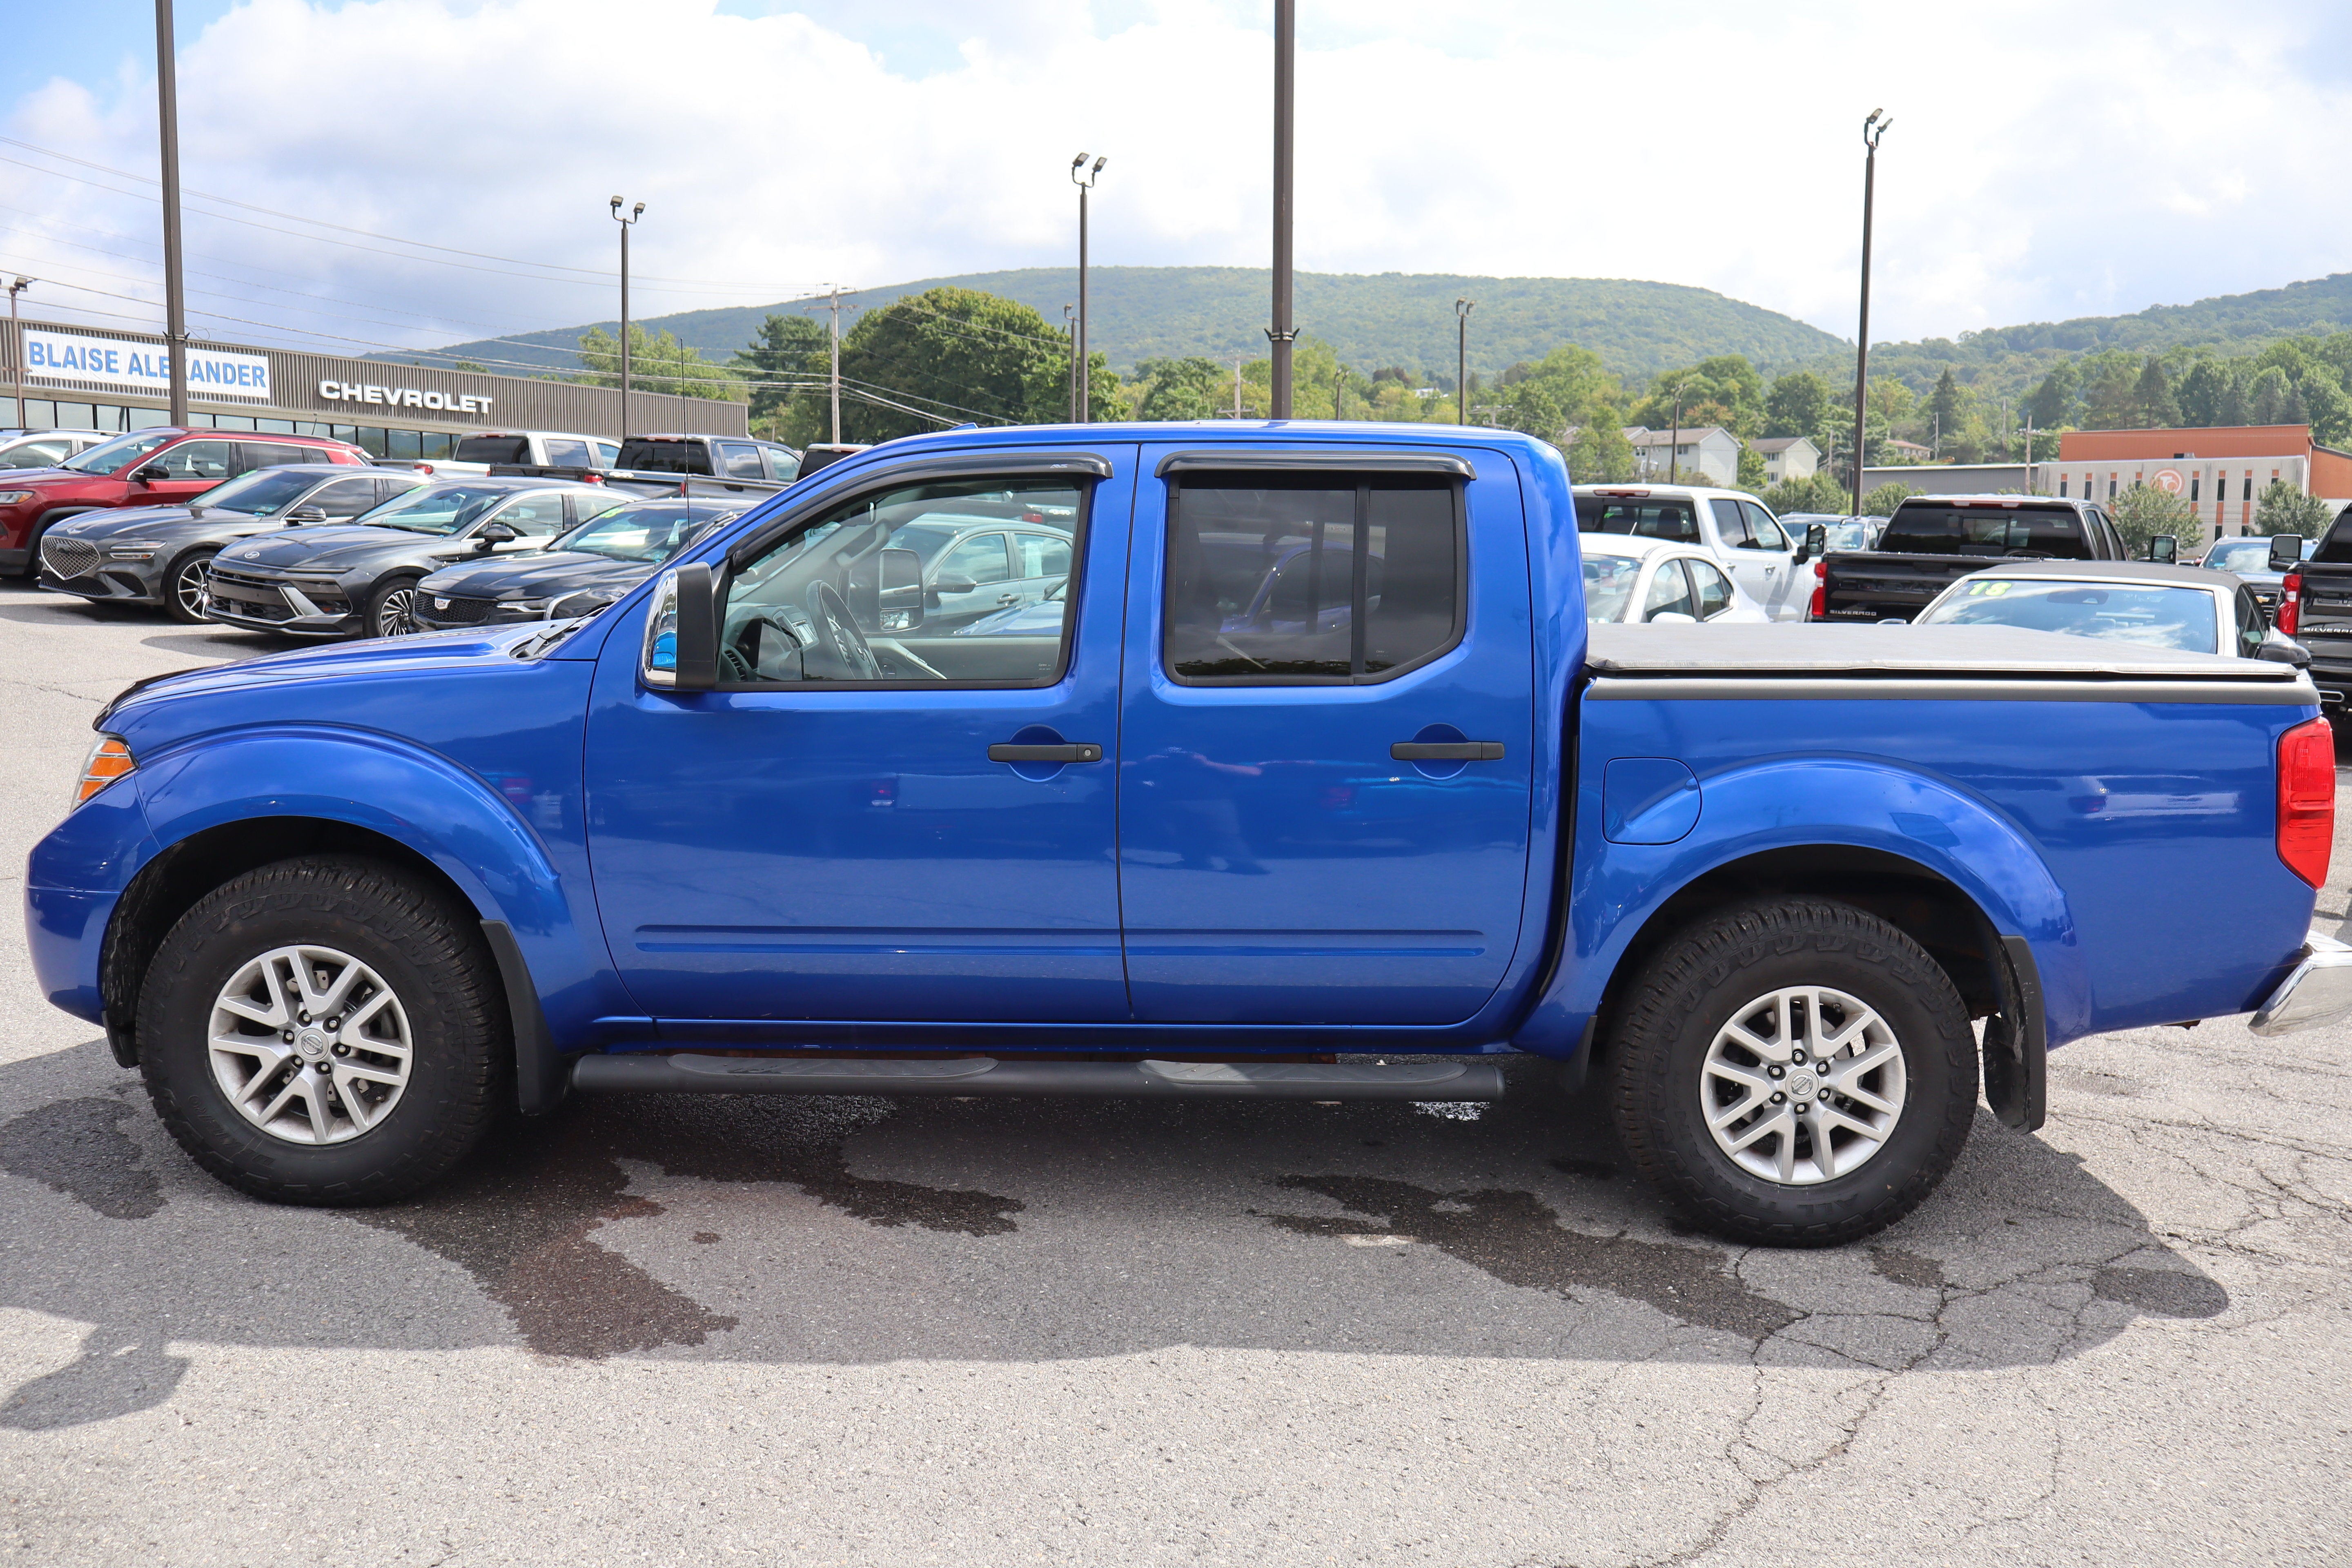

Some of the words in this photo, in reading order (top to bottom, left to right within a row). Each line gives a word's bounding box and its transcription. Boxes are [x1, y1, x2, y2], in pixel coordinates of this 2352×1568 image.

[29, 341, 119, 374] BLAISE
[128, 352, 267, 388] ALEANDER
[319, 380, 493, 414] CHEVROLET
[1969, 581, 2012, 596] 18
